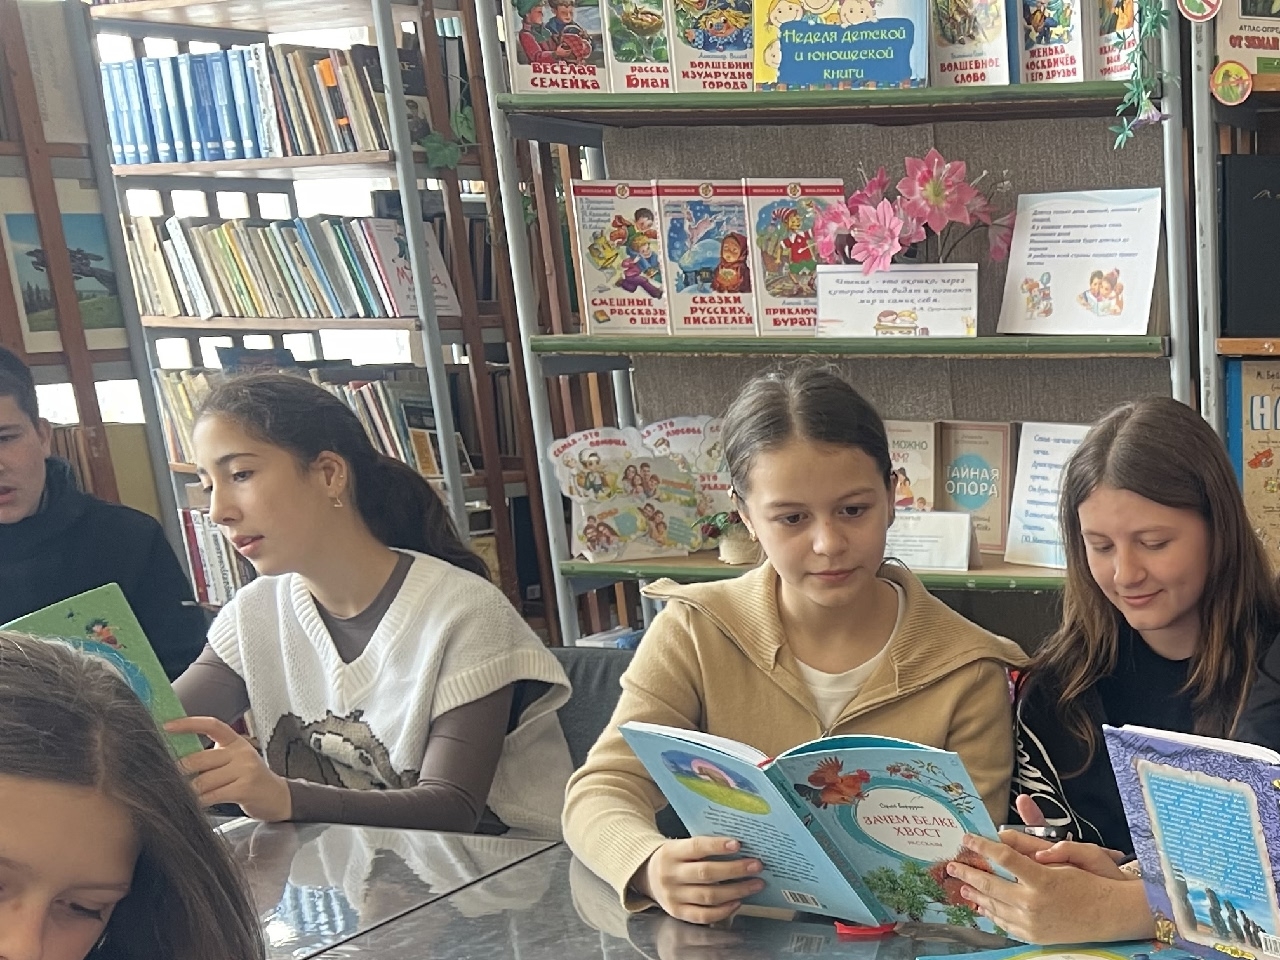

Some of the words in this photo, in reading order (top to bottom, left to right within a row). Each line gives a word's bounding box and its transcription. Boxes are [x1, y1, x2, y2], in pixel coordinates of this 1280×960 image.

[783, 29, 837, 44] Неделя
[841, 26, 906, 42] детской
[1229, 35, 1243, 48] ОТ
[795, 52, 803, 61] и
[808, 47, 894, 61] юношеской
[1029, 46, 1065, 58] ЖЕНЬКА
[940, 57, 1000, 72] ВОЛШЕБНОЕ
[823, 69, 864, 79] книги
[954, 72, 986, 83] СЛОВО
[1031, 70, 1043, 82] ЕГО
[1046, 68, 1077, 80] ДРУЗЬЯ
[530, 76, 600, 89] СЕМЕЙКА
[702, 81, 748, 90] ГОРОДА
[591, 297, 654, 307] СМЕШНЫЕ
[692, 296, 742, 305] СКАЗКИ
[690, 306, 746, 315] РУССКИХ
[892, 440, 928, 451] МОЖНО
[946, 464, 1000, 480] ТАЙНАЯ
[945, 480, 999, 498] ОПОРА
[863, 816, 910, 825] ЗАЧЕМ
[912, 816, 958, 828] БЕЛКЕ
[893, 826, 941, 838] ХВОСТ
